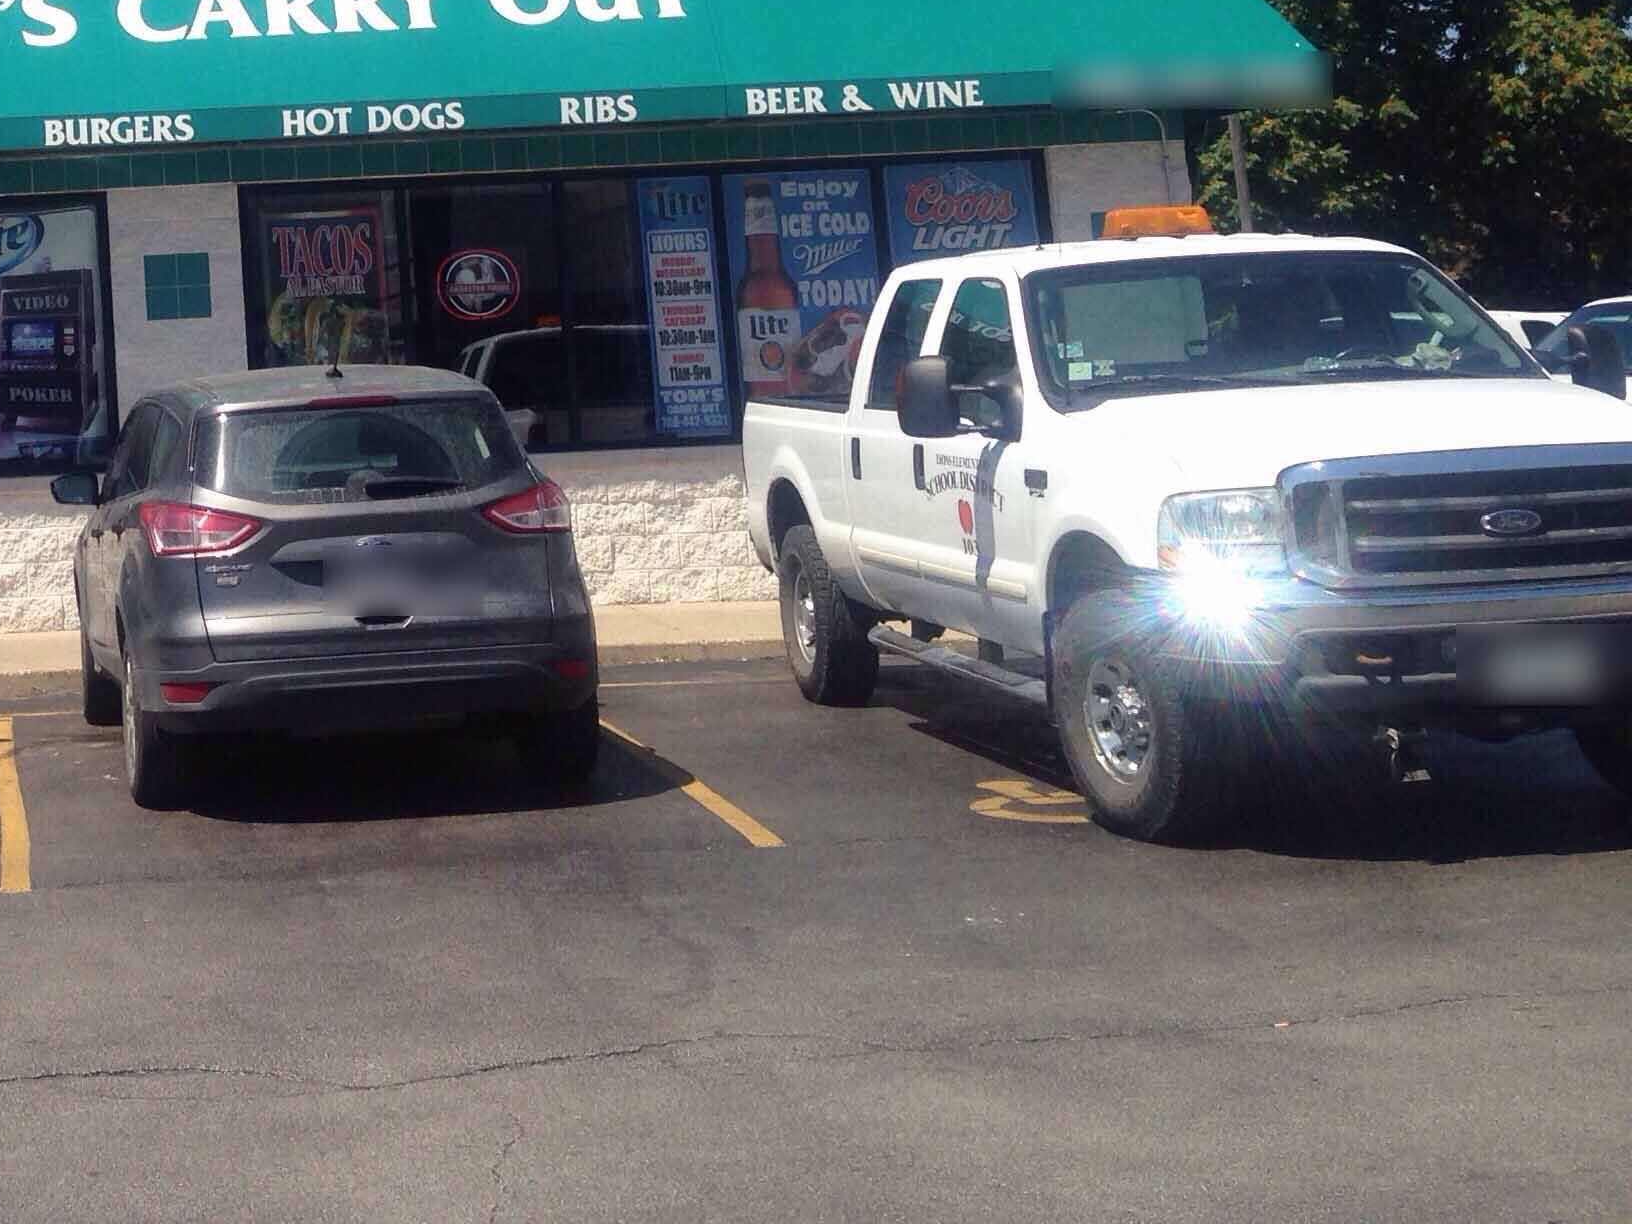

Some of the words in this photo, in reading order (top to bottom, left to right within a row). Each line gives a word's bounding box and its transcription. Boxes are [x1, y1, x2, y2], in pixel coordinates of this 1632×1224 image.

[560, 95, 638, 124] RIBS
[746, 86, 827, 115] BEER
[841, 84, 872, 112] &
[888, 80, 984, 109] WINE
[44, 114, 195, 146] BURGERS
[282, 107, 352, 137] HOT
[367, 102, 465, 132] DOGS
[780, 179, 859, 198] Enjoy
[905, 178, 1017, 226] Coors
[803, 200, 829, 211] an
[782, 214, 813, 238] ICE
[819, 211, 870, 234] COLD
[913, 224, 1013, 251] LIGHT
[272, 223, 373, 278] TACOS
[651, 232, 707, 252] HOURS
[793, 239, 862, 276] Miller
[13, 295, 70, 311] VIDEO
[749, 316, 788, 340] Lite
[8, 386, 73, 402] POKER
[660, 388, 724, 403] TOM'S
[925, 470, 957, 498] SCHOOL
